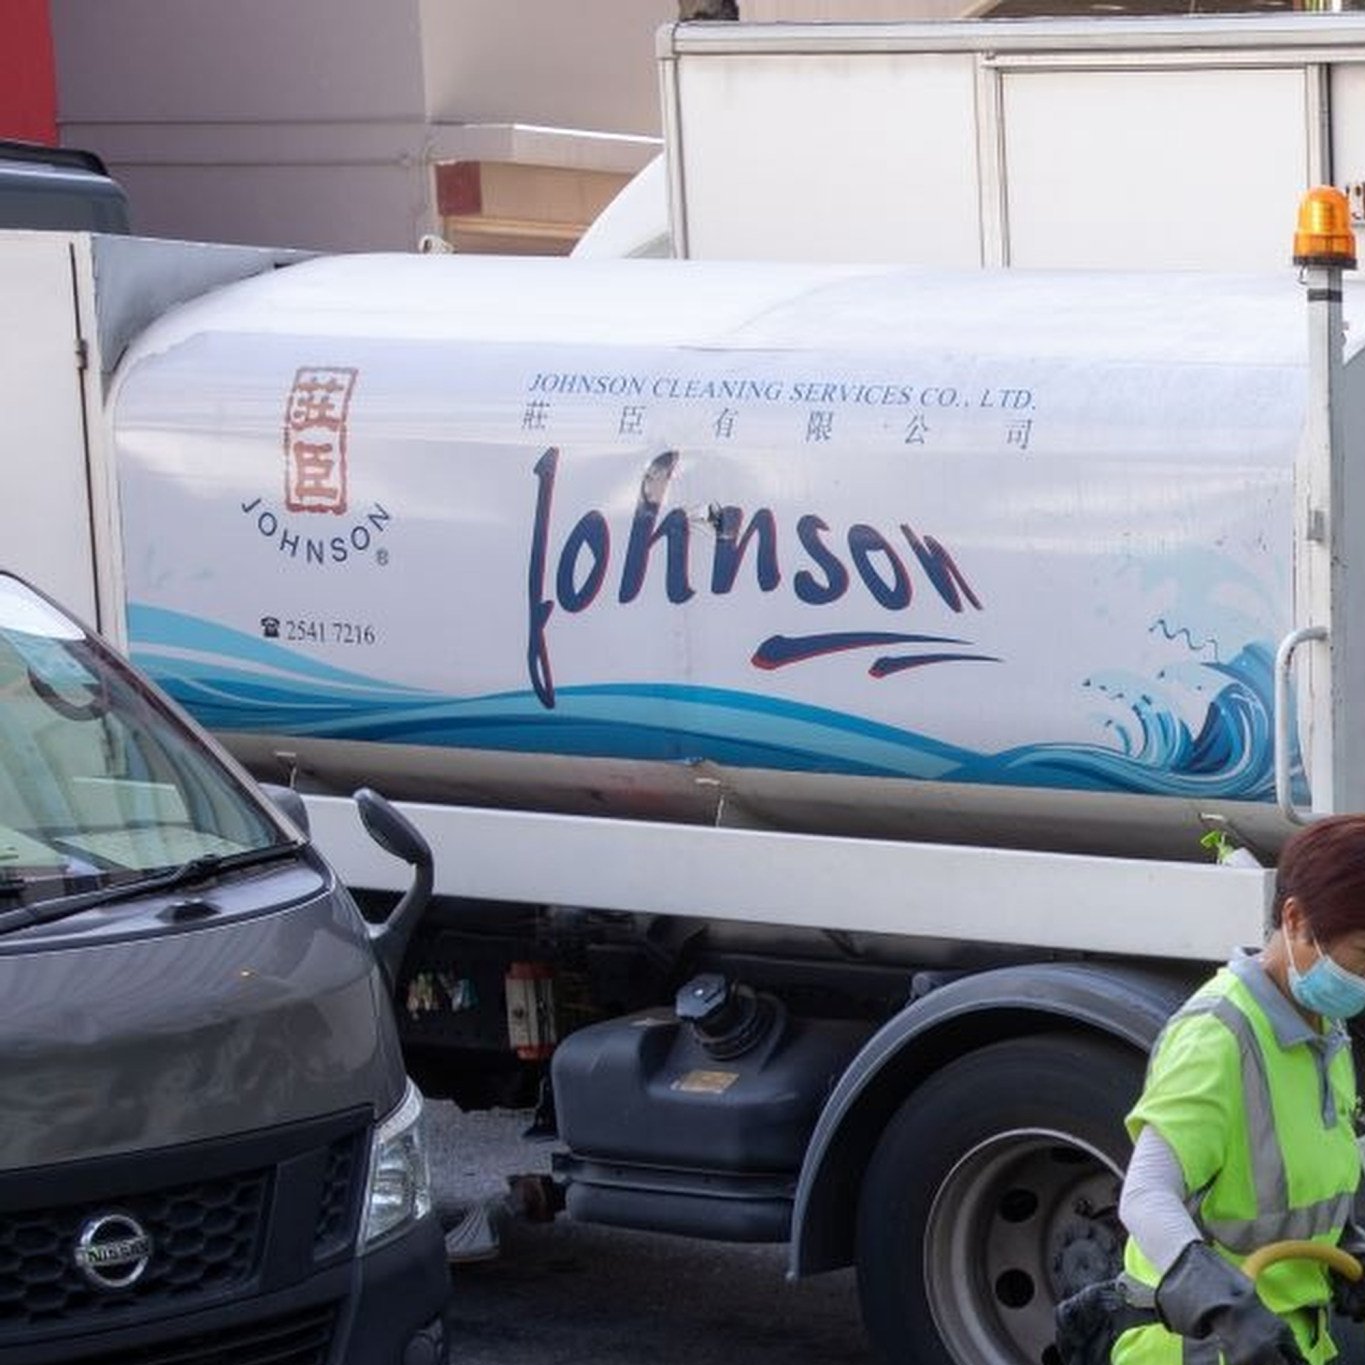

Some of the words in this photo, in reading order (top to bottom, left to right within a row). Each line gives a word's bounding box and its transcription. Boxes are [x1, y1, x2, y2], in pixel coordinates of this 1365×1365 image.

[529, 373, 645, 396] JOHNSON
[652, 377, 782, 400] CLEANING
[789, 382, 914, 406] SERVICES
[980, 388, 1036, 410] LTD.
[241, 497, 391, 565] JOHNSON
[528, 446, 983, 709] Johnson
[286, 620, 326, 642] 2541
[333, 623, 376, 645] 7216
